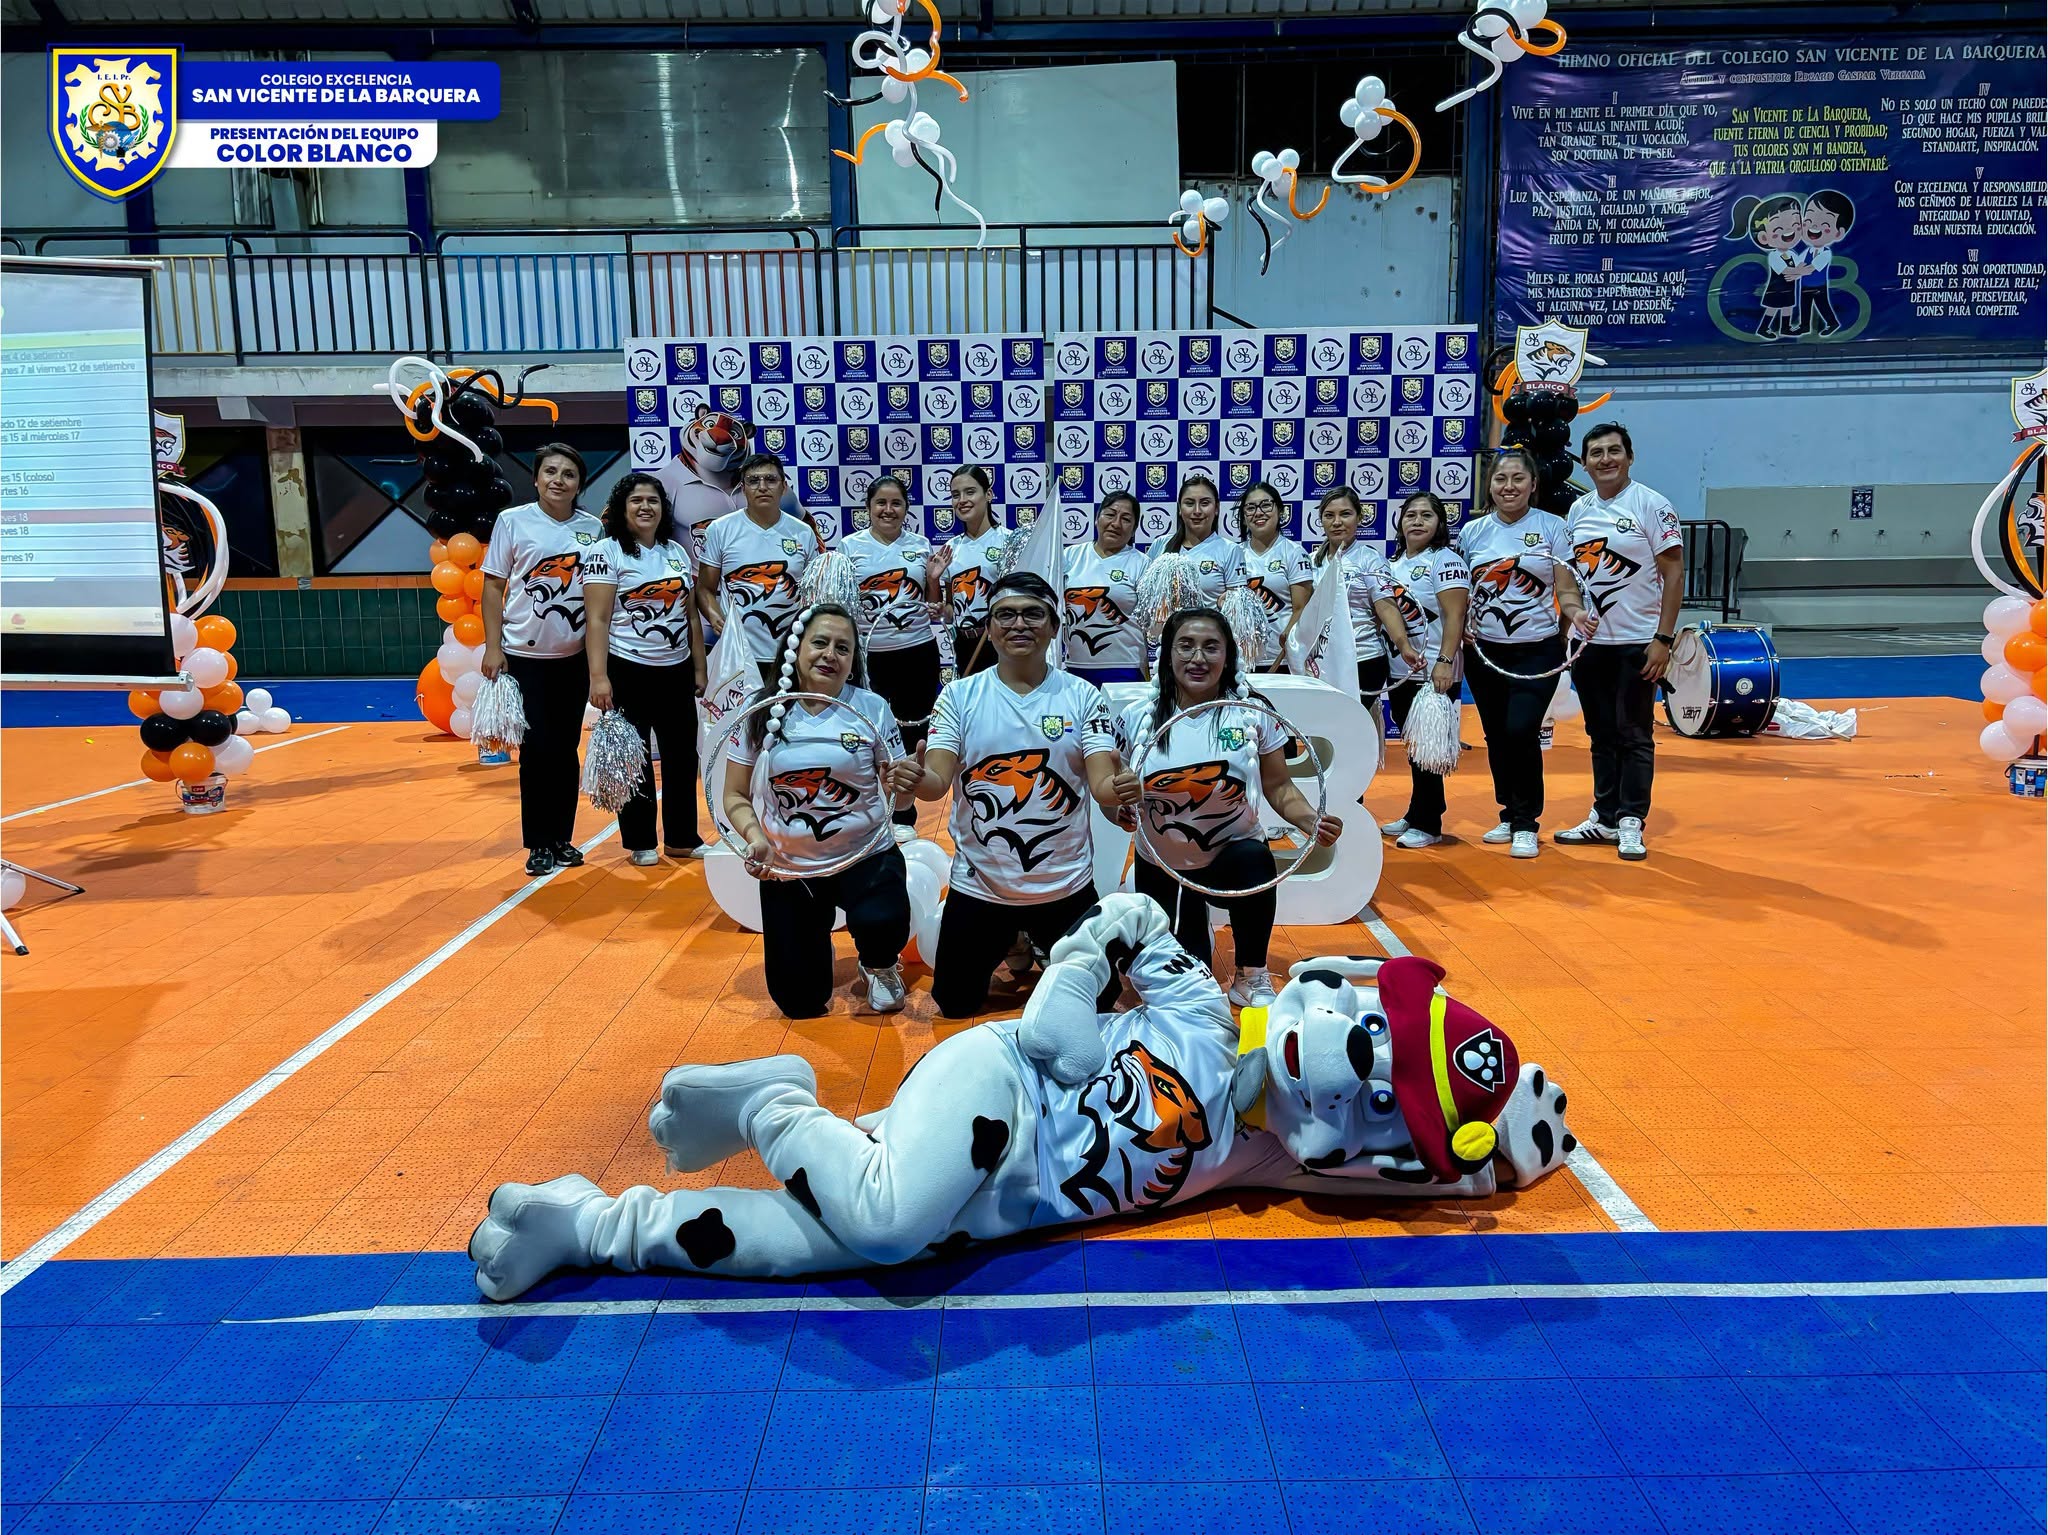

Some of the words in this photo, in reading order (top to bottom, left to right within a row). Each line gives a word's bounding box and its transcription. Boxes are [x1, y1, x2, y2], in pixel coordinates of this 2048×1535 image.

[1559, 53, 1610, 68] HIMNO
[1618, 52, 1677, 66] OFICIAL
[1685, 51, 1714, 65] DEL
[1723, 49, 1788, 65] COLEGIO
[1796, 49, 1826, 63] SAN
[1835, 47, 1899, 61] VICENTE
[1907, 47, 1927, 60] DE
[1936, 47, 1954, 60] LA
[1964, 44, 2046, 60] BARQUERA
[1900, 100, 1910, 110] ES
[1915, 99, 1936, 110] SOLO
[1941, 99, 1953, 110] UN
[1958, 98, 1986, 109] TECHO
[1991, 98, 2008, 109] CON
[1539, 107, 1550, 119] EN
[1556, 107, 1565, 119] MI
[1571, 107, 1600, 118] MENTE
[1605, 106, 1616, 118] EL
[1621, 105, 1654, 117] PRIMER
[1659, 103, 1674, 116] DÍA
[1679, 105, 1698, 119] QUE
[1703, 105, 1718, 117] YO,
[1556, 121, 1572, 132] TUS
[1578, 121, 1605, 131] AULAS
[1611, 120, 1650, 131] INFANTIL
[1655, 117, 1685, 131] ACUDÍ;
[1902, 114, 1912, 124] LO
[1918, 114, 1935, 126] QUE
[1940, 113, 1962, 124] HACE
[1967, 113, 1981, 123] MIS
[1986, 113, 2021, 123] PUPILAS
[1539, 137, 1556, 147] TAN
[1561, 135, 1596, 146] GRANDE
[1601, 135, 1620, 147] FUE,
[1625, 135, 1637, 145] TU
[1643, 131, 1689, 145] VOCACIÓN,
[1713, 128, 1743, 141] FUENTE
[1748, 127, 1779, 139] ETERNA
[1784, 127, 1794, 139] DE
[1799, 126, 1830, 138] CIENCIA
[1845, 124, 1888, 139] PROBIDAD;
[1902, 128, 1941, 138] SEGUNDO
[1946, 127, 1978, 139] HOGAR,
[1983, 127, 2015, 137] FUERZA
[1733, 144, 1749, 157] TUS
[1753, 143, 1788, 155] COLORES
[1793, 142, 1808, 155] SON
[1813, 142, 1823, 154] MI
[1827, 142, 1866, 156] BANDERA,
[1923, 141, 1979, 153] ESTANDARTE,
[1984, 138, 2039, 152] INSPIRACIÓN.
[1551, 150, 1567, 161] SOY
[1574, 149, 1618, 160] DOCTRINA
[1624, 149, 1635, 159] DE
[1641, 148, 1652, 158] TU
[1657, 148, 1675, 158] SER.
[1710, 161, 1726, 176] QUE
[1741, 162, 1751, 174] LA
[1756, 159, 1784, 173] PATRIA
[1790, 158, 1836, 172] ORGULLOSO
[1895, 180, 1913, 193] CON
[1918, 182, 1967, 193] EXCELENCIA
[1898, 197, 1915, 207] NOS
[1920, 194, 1955, 207] CEÑIMOS
[1960, 196, 1971, 206] DE
[1976, 196, 2017, 206] LAURELES
[2022, 196, 2033, 206] LA
[1919, 210, 1969, 221] INTEGRIDAD
[1985, 210, 2032, 222] VOLUNTAD,
[1913, 225, 1940, 235] BASAN
[1944, 224, 1982, 235] NUESTRA
[1987, 221, 2036, 235] EDUCACIÓN.
[1919, 262, 1957, 275] DESAFÍOS
[1962, 264, 1978, 274] SON
[1983, 263, 2046, 275] OPORTUNIDAD,
[1559, 273, 1570, 284] DE
[1575, 272, 1604, 283] HORAS
[1610, 271, 1658, 282] DEDICADAS
[1663, 268, 1687, 284] AQUÍ,
[1902, 278, 1912, 288] EL
[1917, 278, 1944, 288] SABER
[1948, 278, 1958, 288] ES
[1962, 278, 2009, 288] FORTALEZA
[2014, 278, 2039, 289] REAL;
[1911, 292, 1966, 302] DETERMINAR,
[1971, 292, 2027, 303] PERSEVERAR,
[1537, 301, 1544, 311] SI
[1550, 300, 1584, 311] ALGUNA
[1589, 299, 1607, 312] VEZ,
[1613, 299, 1628, 310] LAS
[1917, 305, 1944, 316] DONES
[1949, 305, 1970, 315] PARA
[1976, 305, 2019, 315] COMPETIR.
[1567, 313, 1602, 325] VALORO
[1608, 312, 1625, 324] CON
[1630, 312, 1666, 324] FERVOR.
[37, 365, 66, 373] viernes
[68, 364, 77, 372] 12
[80, 363, 90, 371] de
[94, 362, 135, 370] setiembre
[1526, 383, 1564, 391] BLANCO
[17, 420, 25, 428] 12
[11, 432, 19, 441] 15
[31, 431, 69, 441] miércoles
[71, 431, 79, 440] 17
[12, 473, 21, 482] 15
[20, 487, 28, 495] 16
[20, 526, 28, 535] 18
[24, 553, 33, 561] 19
[1438, 570, 1468, 581] TEAM
